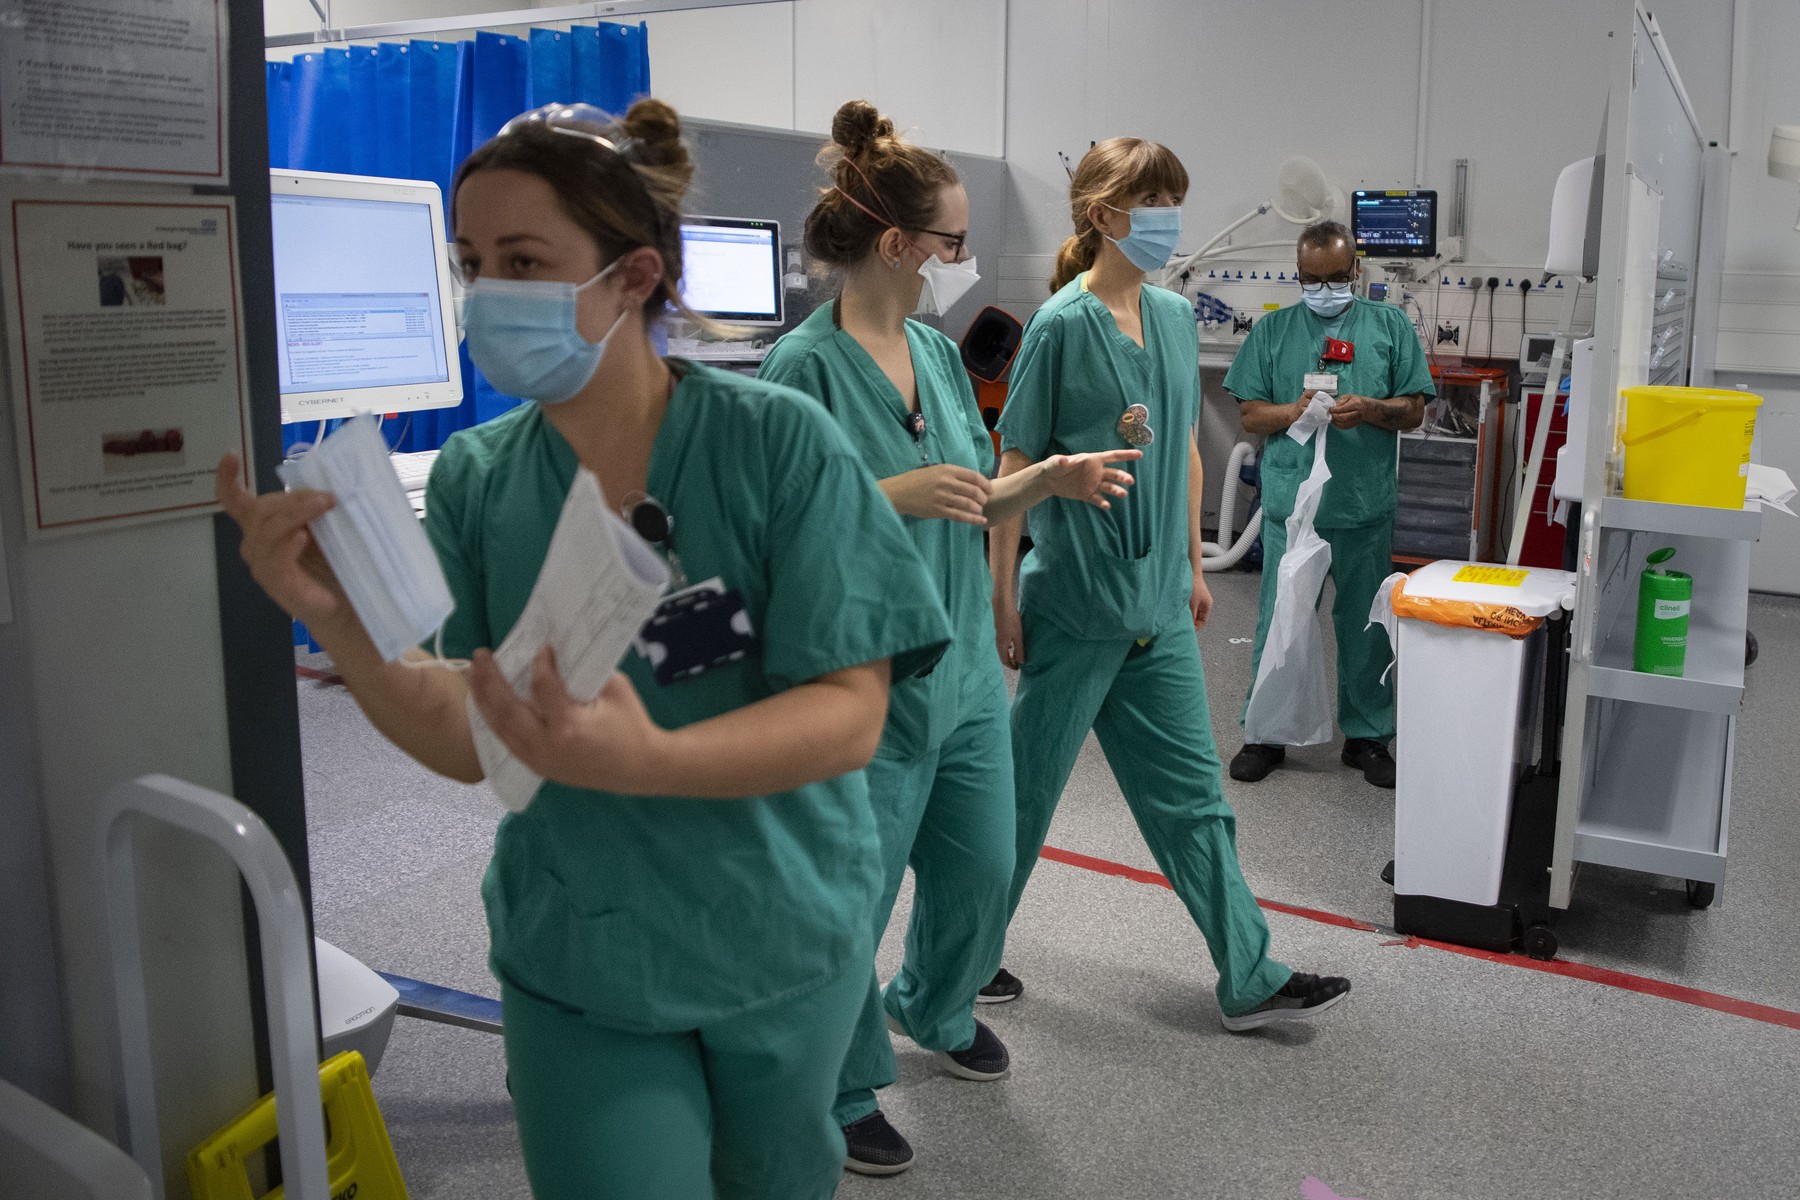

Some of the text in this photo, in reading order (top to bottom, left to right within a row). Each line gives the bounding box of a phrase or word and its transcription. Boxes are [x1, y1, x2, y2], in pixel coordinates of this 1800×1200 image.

[67, 241, 91, 250] Have
[95, 243, 112, 251] you
[115, 242, 136, 250] seen
[147, 241, 164, 250] Red
[166, 241, 187, 252] bag?
[298, 396, 344, 406] CYBERNET
